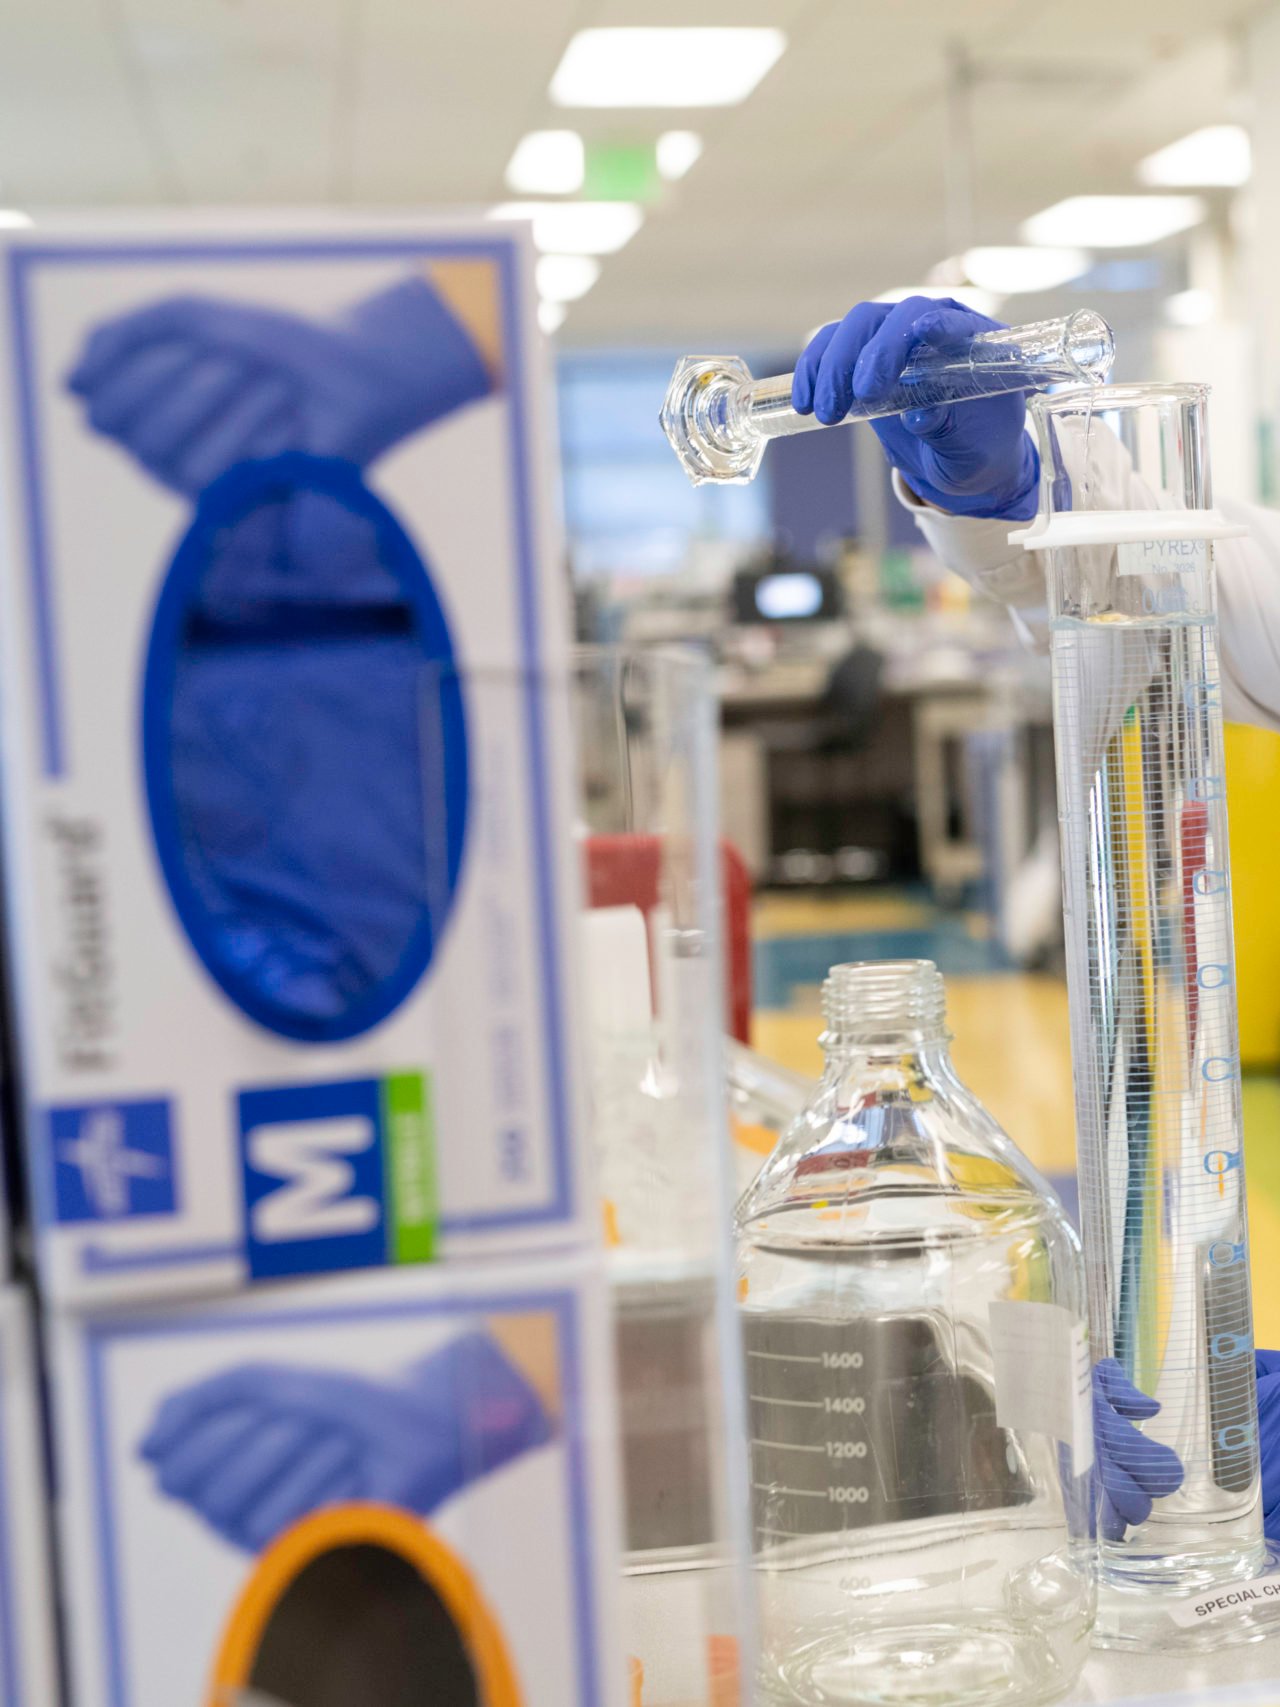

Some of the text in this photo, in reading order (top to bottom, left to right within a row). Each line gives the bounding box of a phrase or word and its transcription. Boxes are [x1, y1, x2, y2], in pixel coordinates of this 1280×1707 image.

[246, 1112, 381, 1246] M
[821, 1351, 863, 1369] 1600
[823, 1397, 866, 1414] 1400
[825, 1441, 867, 1459] 1200
[828, 1486, 869, 1503] 1000
[839, 1576, 872, 1591] 600
[1194, 1588, 1262, 1617] SPECIAL
